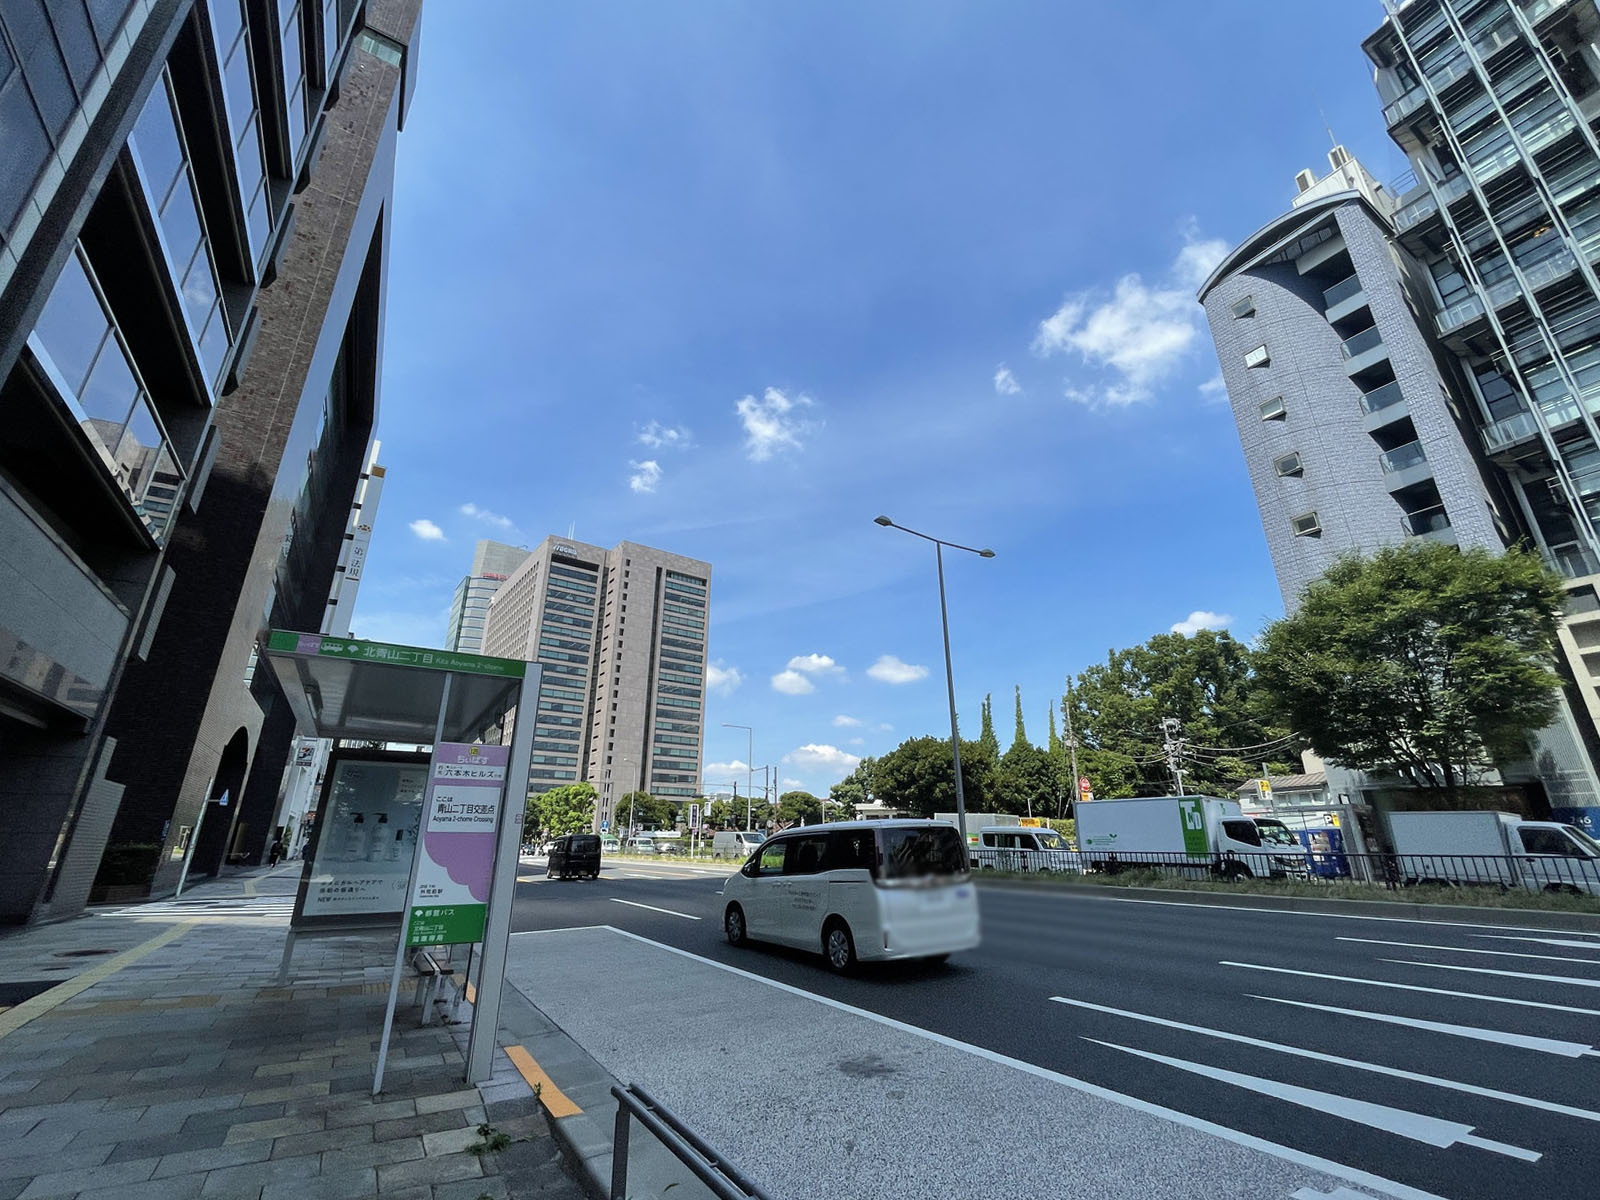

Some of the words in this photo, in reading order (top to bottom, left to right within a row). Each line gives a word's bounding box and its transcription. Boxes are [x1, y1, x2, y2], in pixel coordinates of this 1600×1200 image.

[363, 646, 433, 664] 北青山二丁目
[444, 769, 494, 778] 六本木ヒルズ
[437, 803, 495, 814] 青山二丁目交差点
[432, 815, 451, 823] Aoyama
